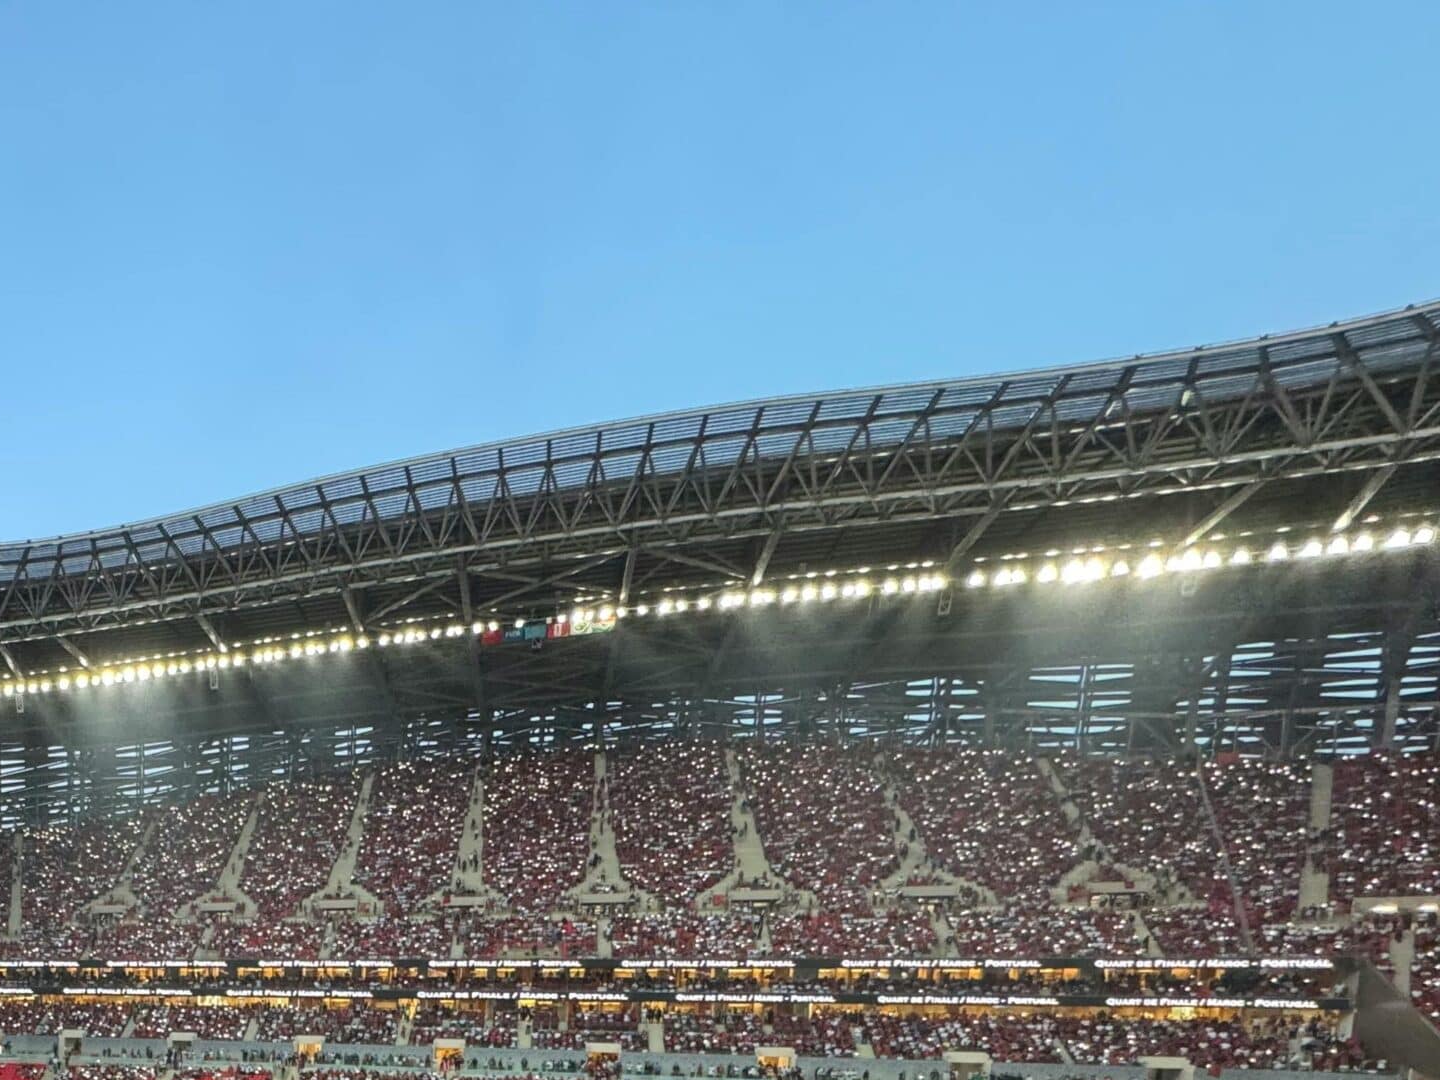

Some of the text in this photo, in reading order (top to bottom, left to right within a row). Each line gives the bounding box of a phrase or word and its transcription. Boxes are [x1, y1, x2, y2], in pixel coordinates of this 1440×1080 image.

[841, 959, 875, 967] QUART
[893, 959, 931, 967] FINALE
[939, 959, 976, 967] MAROC
[985, 959, 1041, 967] PORTUGAL
[1094, 959, 1134, 968] QUART
[1154, 959, 1197, 967] FINALE
[1207, 959, 1249, 967] MAROC
[1260, 959, 1333, 968] PORTUGAL
[569, 992, 628, 1000] PORTUGAL
[877, 995, 909, 1003] QUART
[924, 996, 959, 1004] FINALE
[966, 996, 999, 1004] MAROC
[1007, 997, 1059, 1005] PORTUGAL
[1106, 998, 1141, 1006] QUART
[1141, 998, 1158, 1006] DE
[1159, 998, 1198, 1006] FINALE
[1206, 998, 1245, 1007] MAROC
[1254, 999, 1318, 1008] PORTUGAL
